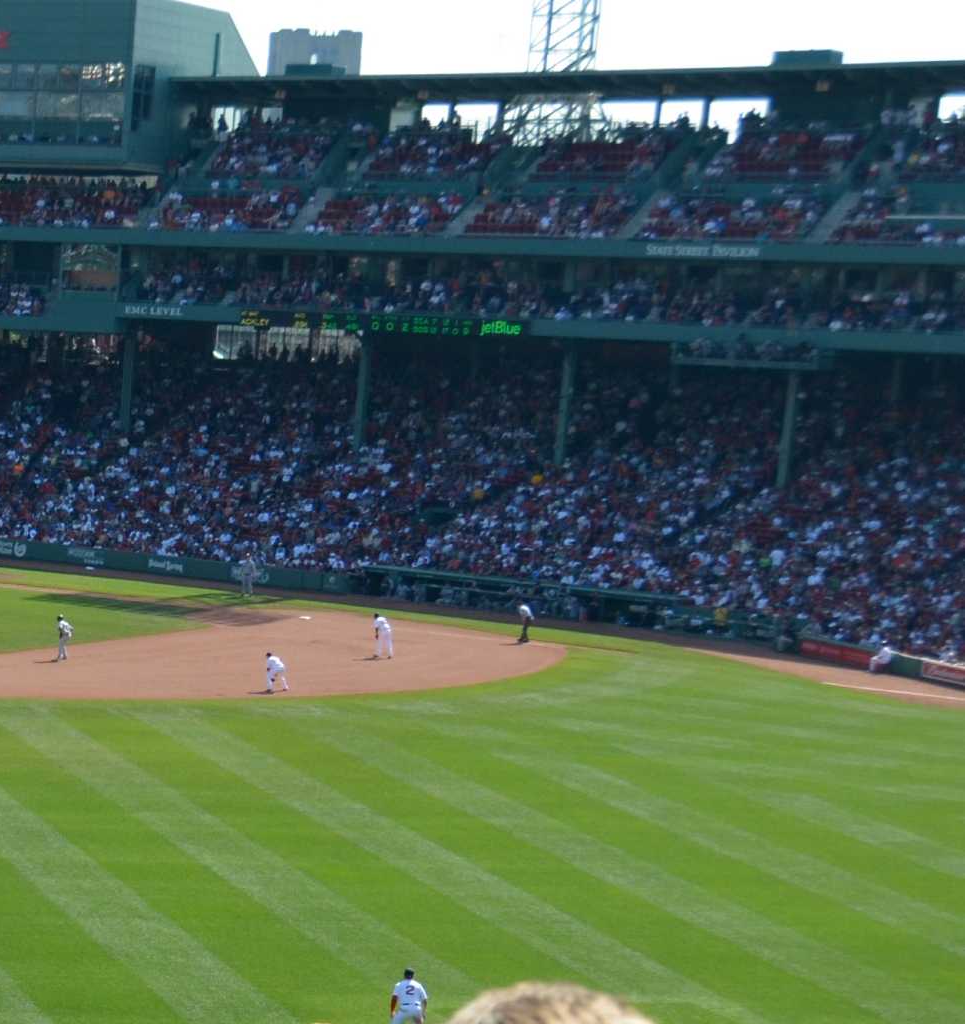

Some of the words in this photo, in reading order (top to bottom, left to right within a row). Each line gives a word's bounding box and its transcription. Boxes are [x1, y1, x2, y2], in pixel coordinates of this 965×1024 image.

[124, 305, 147, 314] EMC
[150, 306, 182, 316] LEVEL
[479, 320, 522, 336] jetBlue
[405, 985, 415, 996] 2
